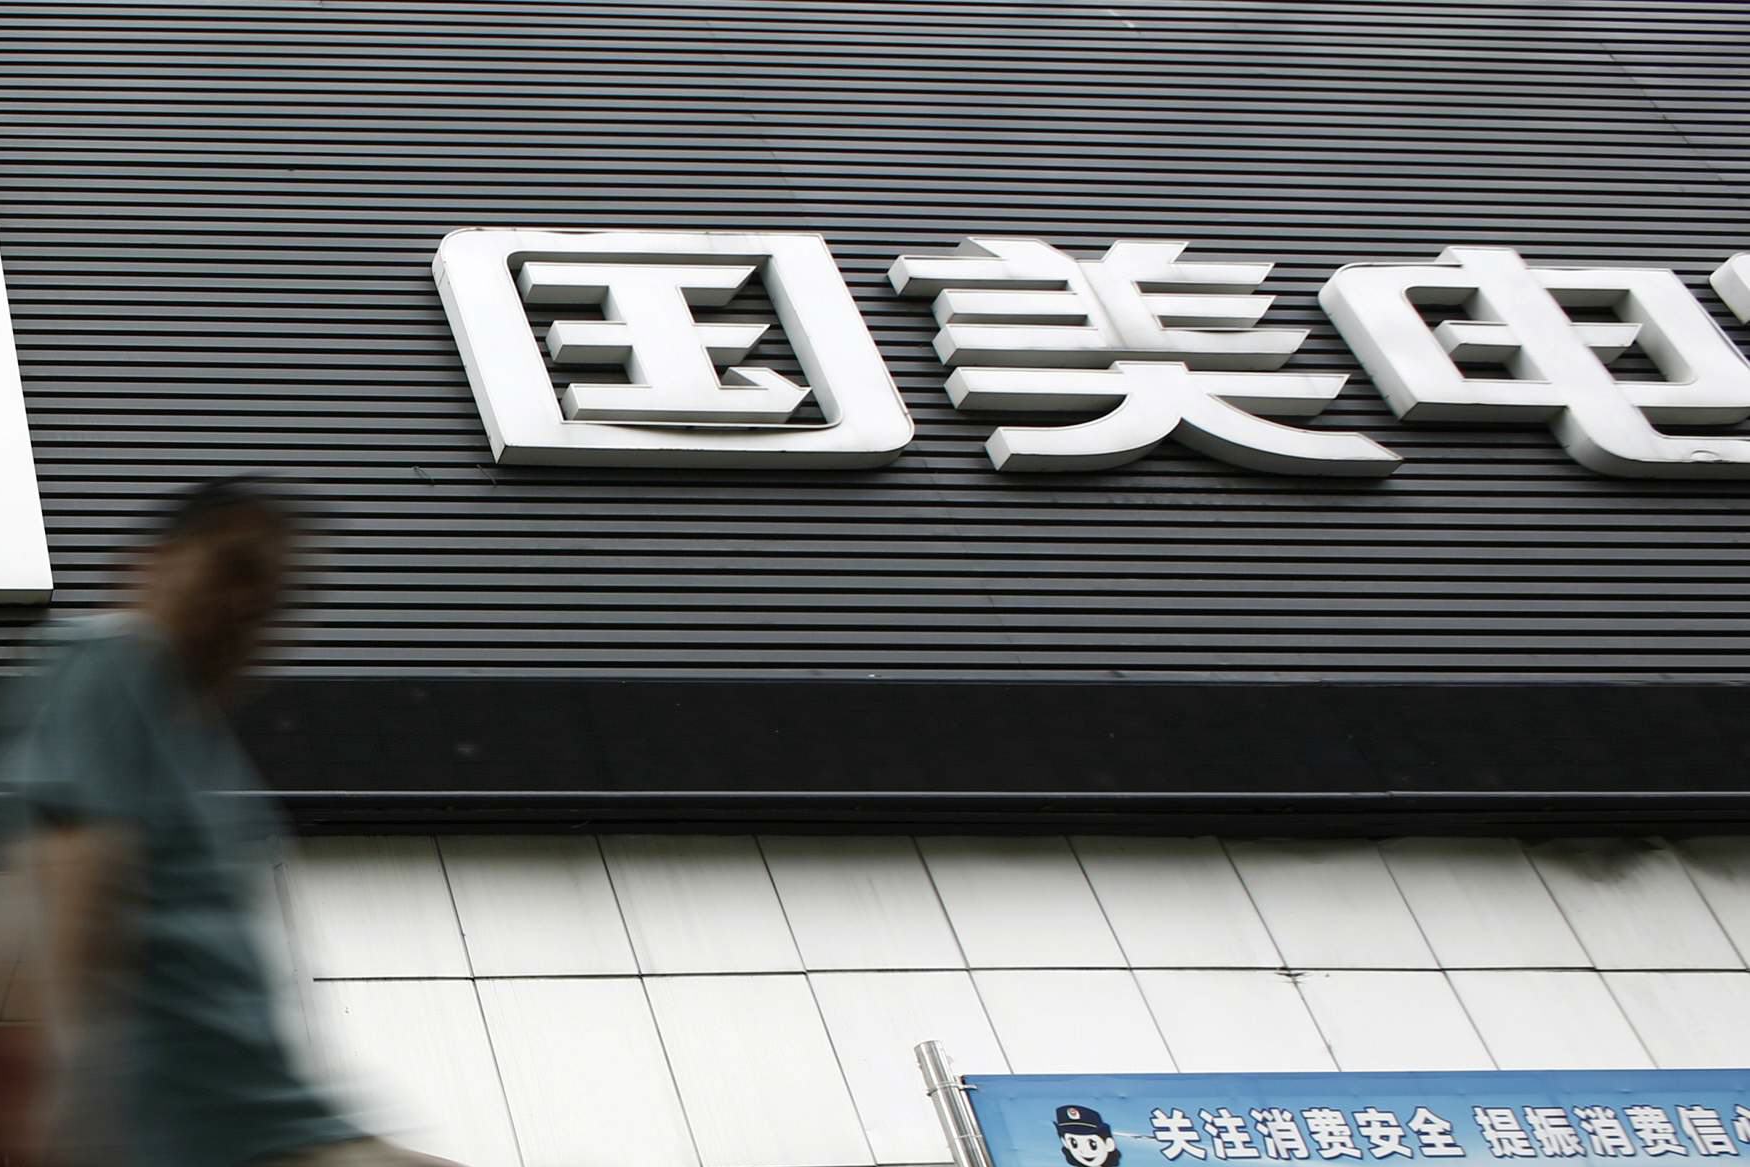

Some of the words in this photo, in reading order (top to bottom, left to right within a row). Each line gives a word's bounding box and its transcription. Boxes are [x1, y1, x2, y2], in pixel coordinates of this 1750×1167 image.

[432, 227, 1750, 478] 国美电
[1149, 1105, 1465, 1163] 关注消费安全
